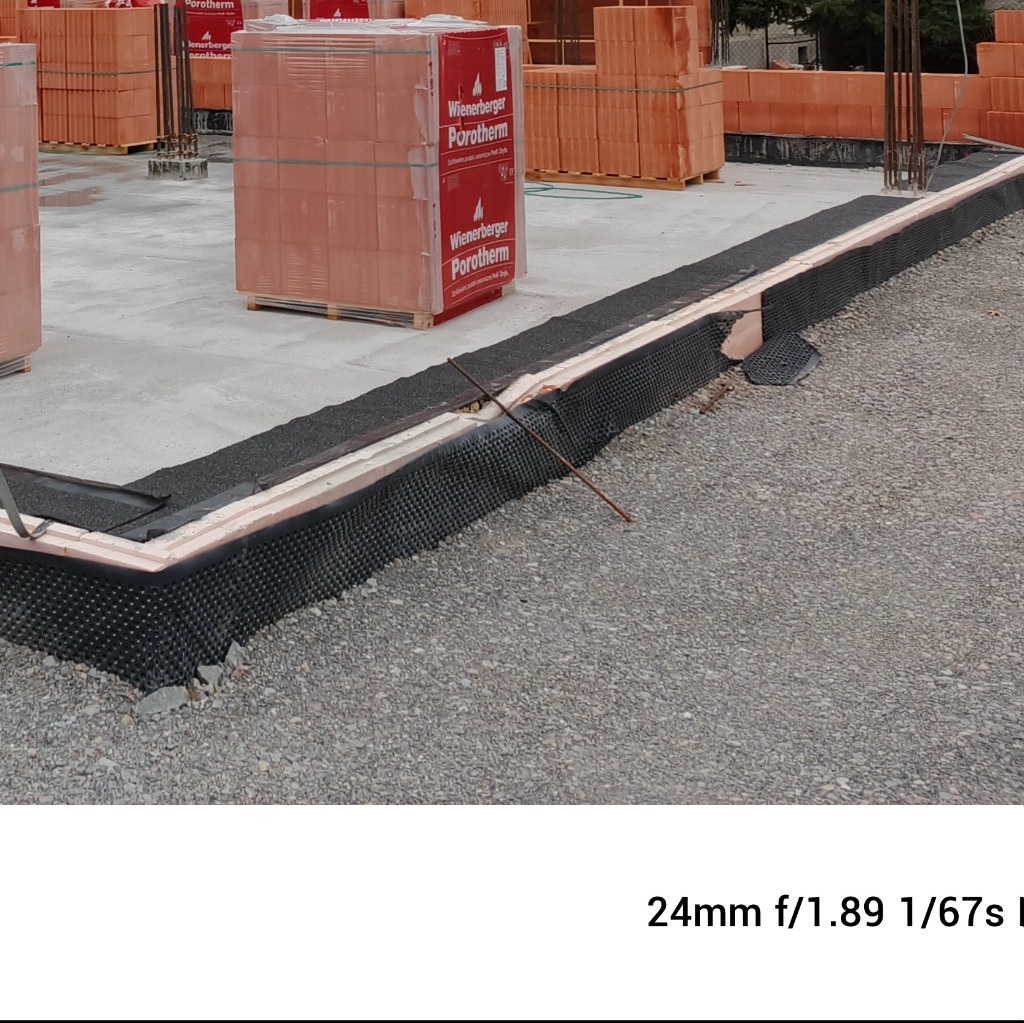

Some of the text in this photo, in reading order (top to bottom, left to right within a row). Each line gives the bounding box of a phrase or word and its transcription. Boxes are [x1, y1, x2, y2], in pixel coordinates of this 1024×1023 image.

[448, 97, 506, 118] Wienerberger
[448, 122, 508, 148] Porotherm
[450, 220, 509, 251] Wienerberger
[451, 244, 510, 280] Porotherm
